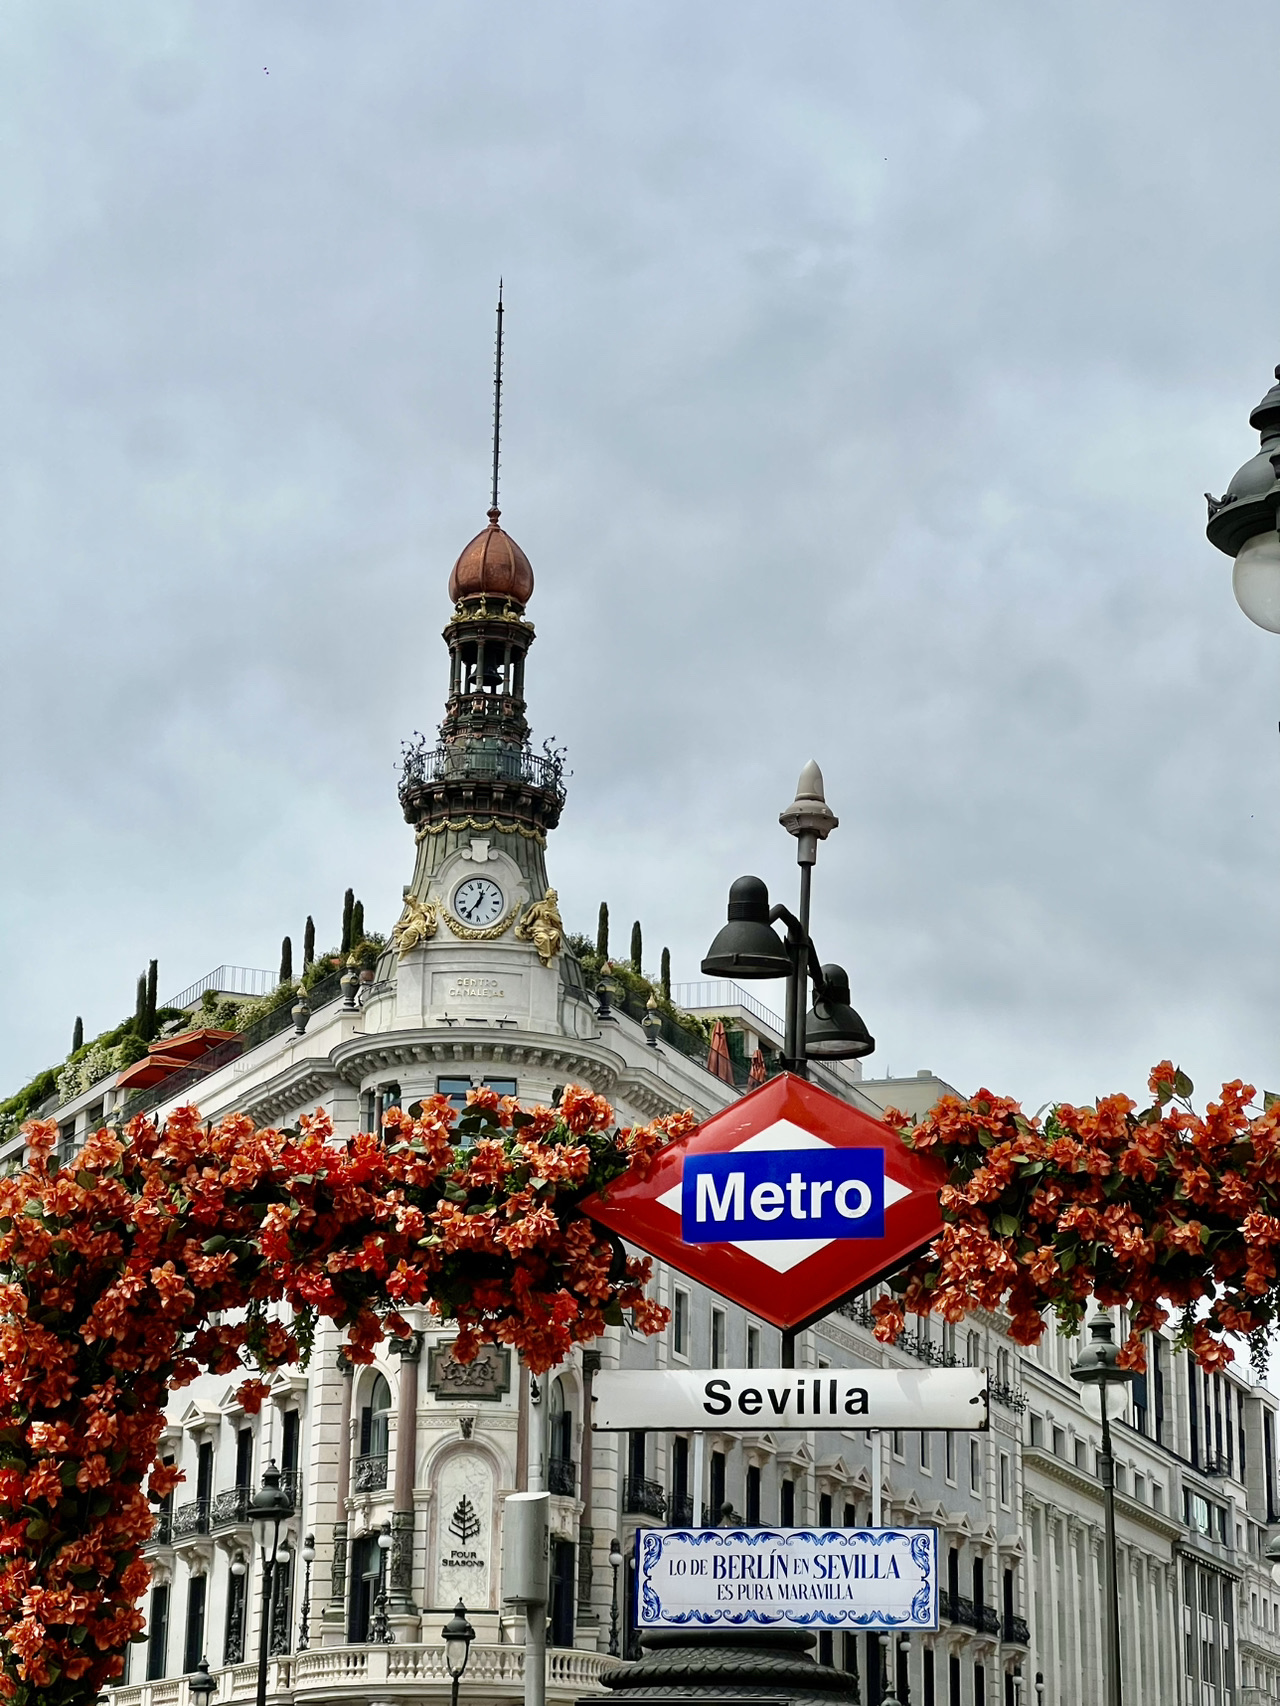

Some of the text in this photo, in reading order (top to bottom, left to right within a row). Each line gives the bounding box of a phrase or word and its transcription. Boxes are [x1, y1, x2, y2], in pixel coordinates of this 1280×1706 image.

[456, 977, 498, 988] CENTRO
[696, 1171, 873, 1223] Metro
[703, 1379, 870, 1416] Sevilla
[442, 1559, 484, 1567] SEASONS
[451, 1551, 476, 1559] FOUR
[669, 1548, 901, 1580] LO DE BERLÍN EN SEVILLA
[717, 1583, 854, 1601] ES PURA MARAVILLA
